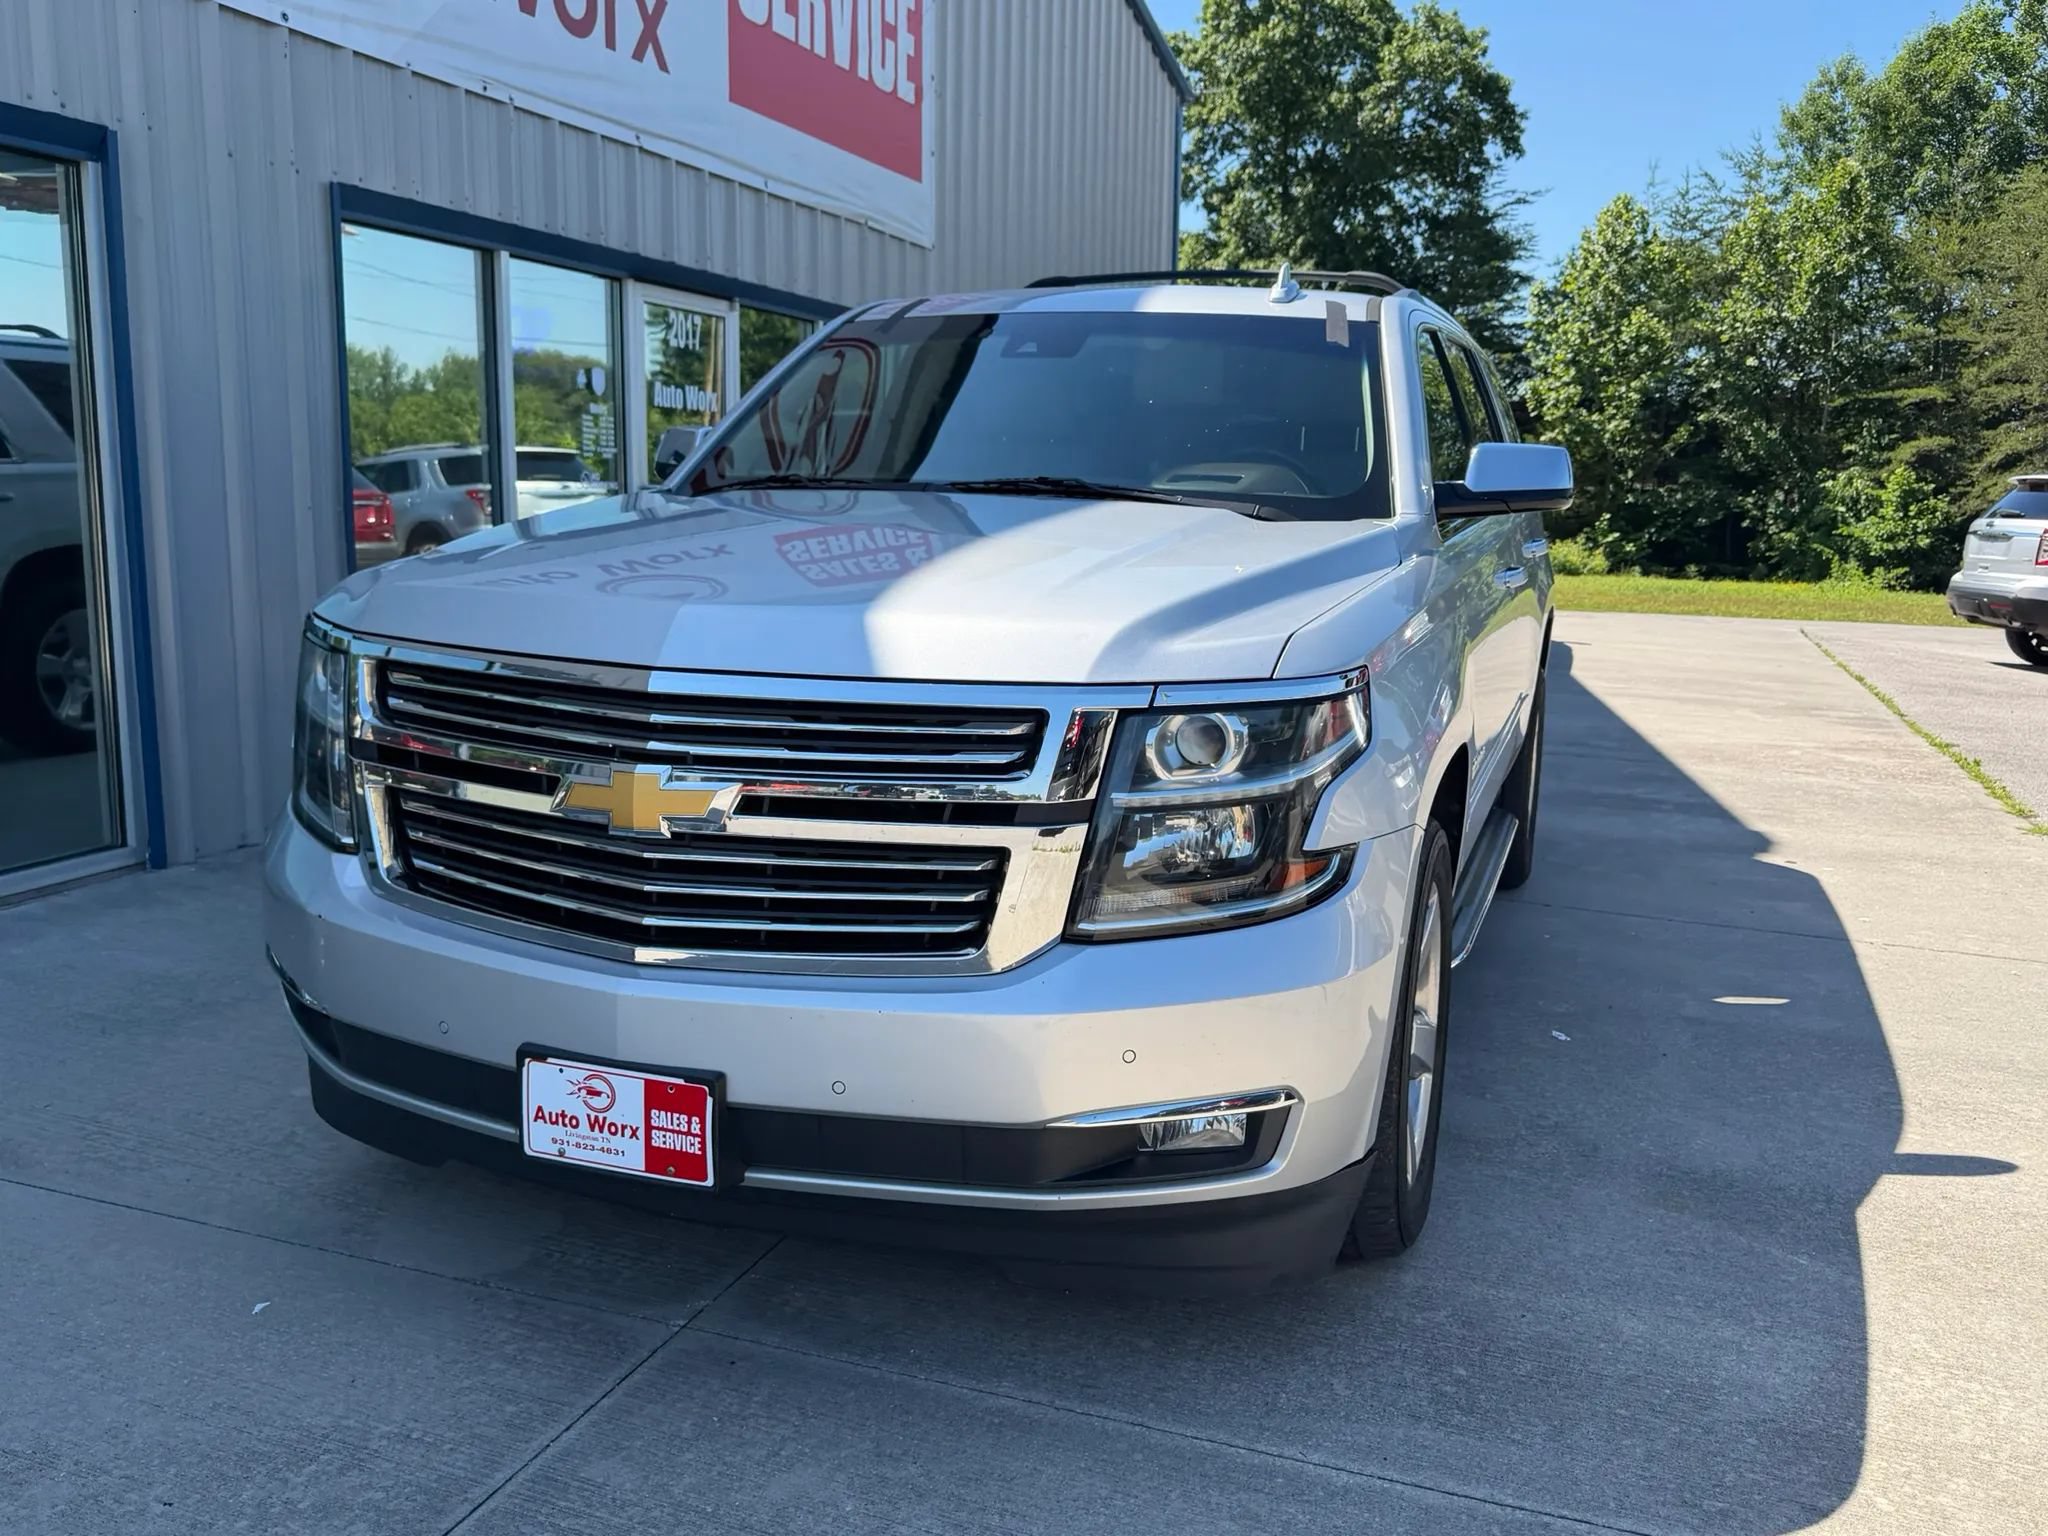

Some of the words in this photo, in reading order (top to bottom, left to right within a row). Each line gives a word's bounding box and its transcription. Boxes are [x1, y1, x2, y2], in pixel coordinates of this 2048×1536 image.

[654, 381, 683, 409] Auto
[685, 385, 718, 412] Worx
[533, 1105, 580, 1129] Auto
[586, 1114, 641, 1140] Worx
[651, 1109, 687, 1130] SALES
[688, 1117, 701, 1135] &
[551, 1137, 625, 1157] 931-823-4831
[651, 1129, 702, 1155] SERVICE
